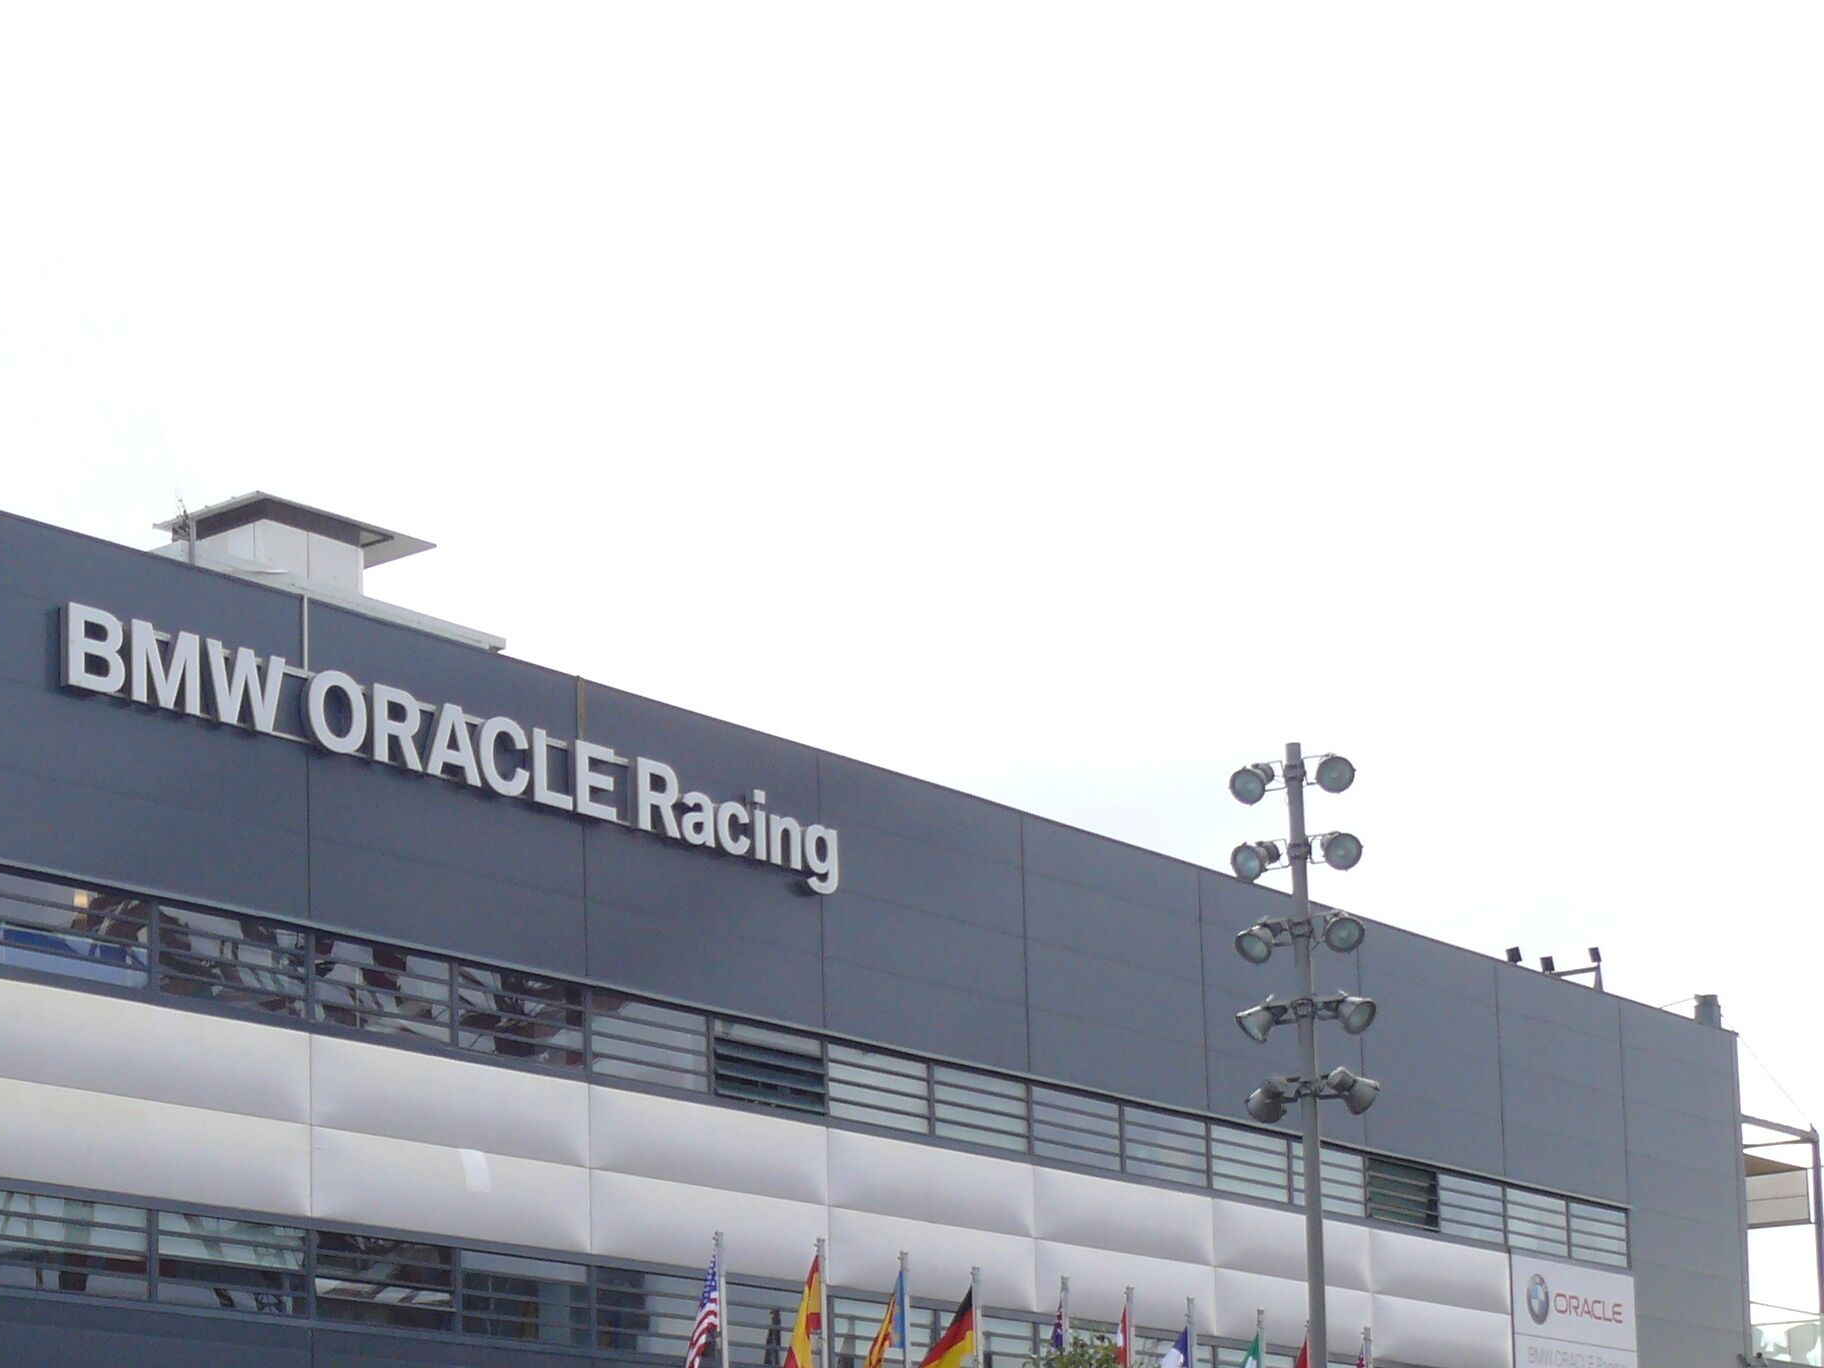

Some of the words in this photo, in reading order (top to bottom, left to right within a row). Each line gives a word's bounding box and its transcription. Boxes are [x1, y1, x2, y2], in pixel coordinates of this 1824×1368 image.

[64, 600, 286, 735] BMW
[305, 670, 624, 822] ORACLE
[636, 756, 840, 894] Racing
[1553, 1292, 1623, 1324] ORACLE
[1528, 1346, 1552, 1365] BMW
